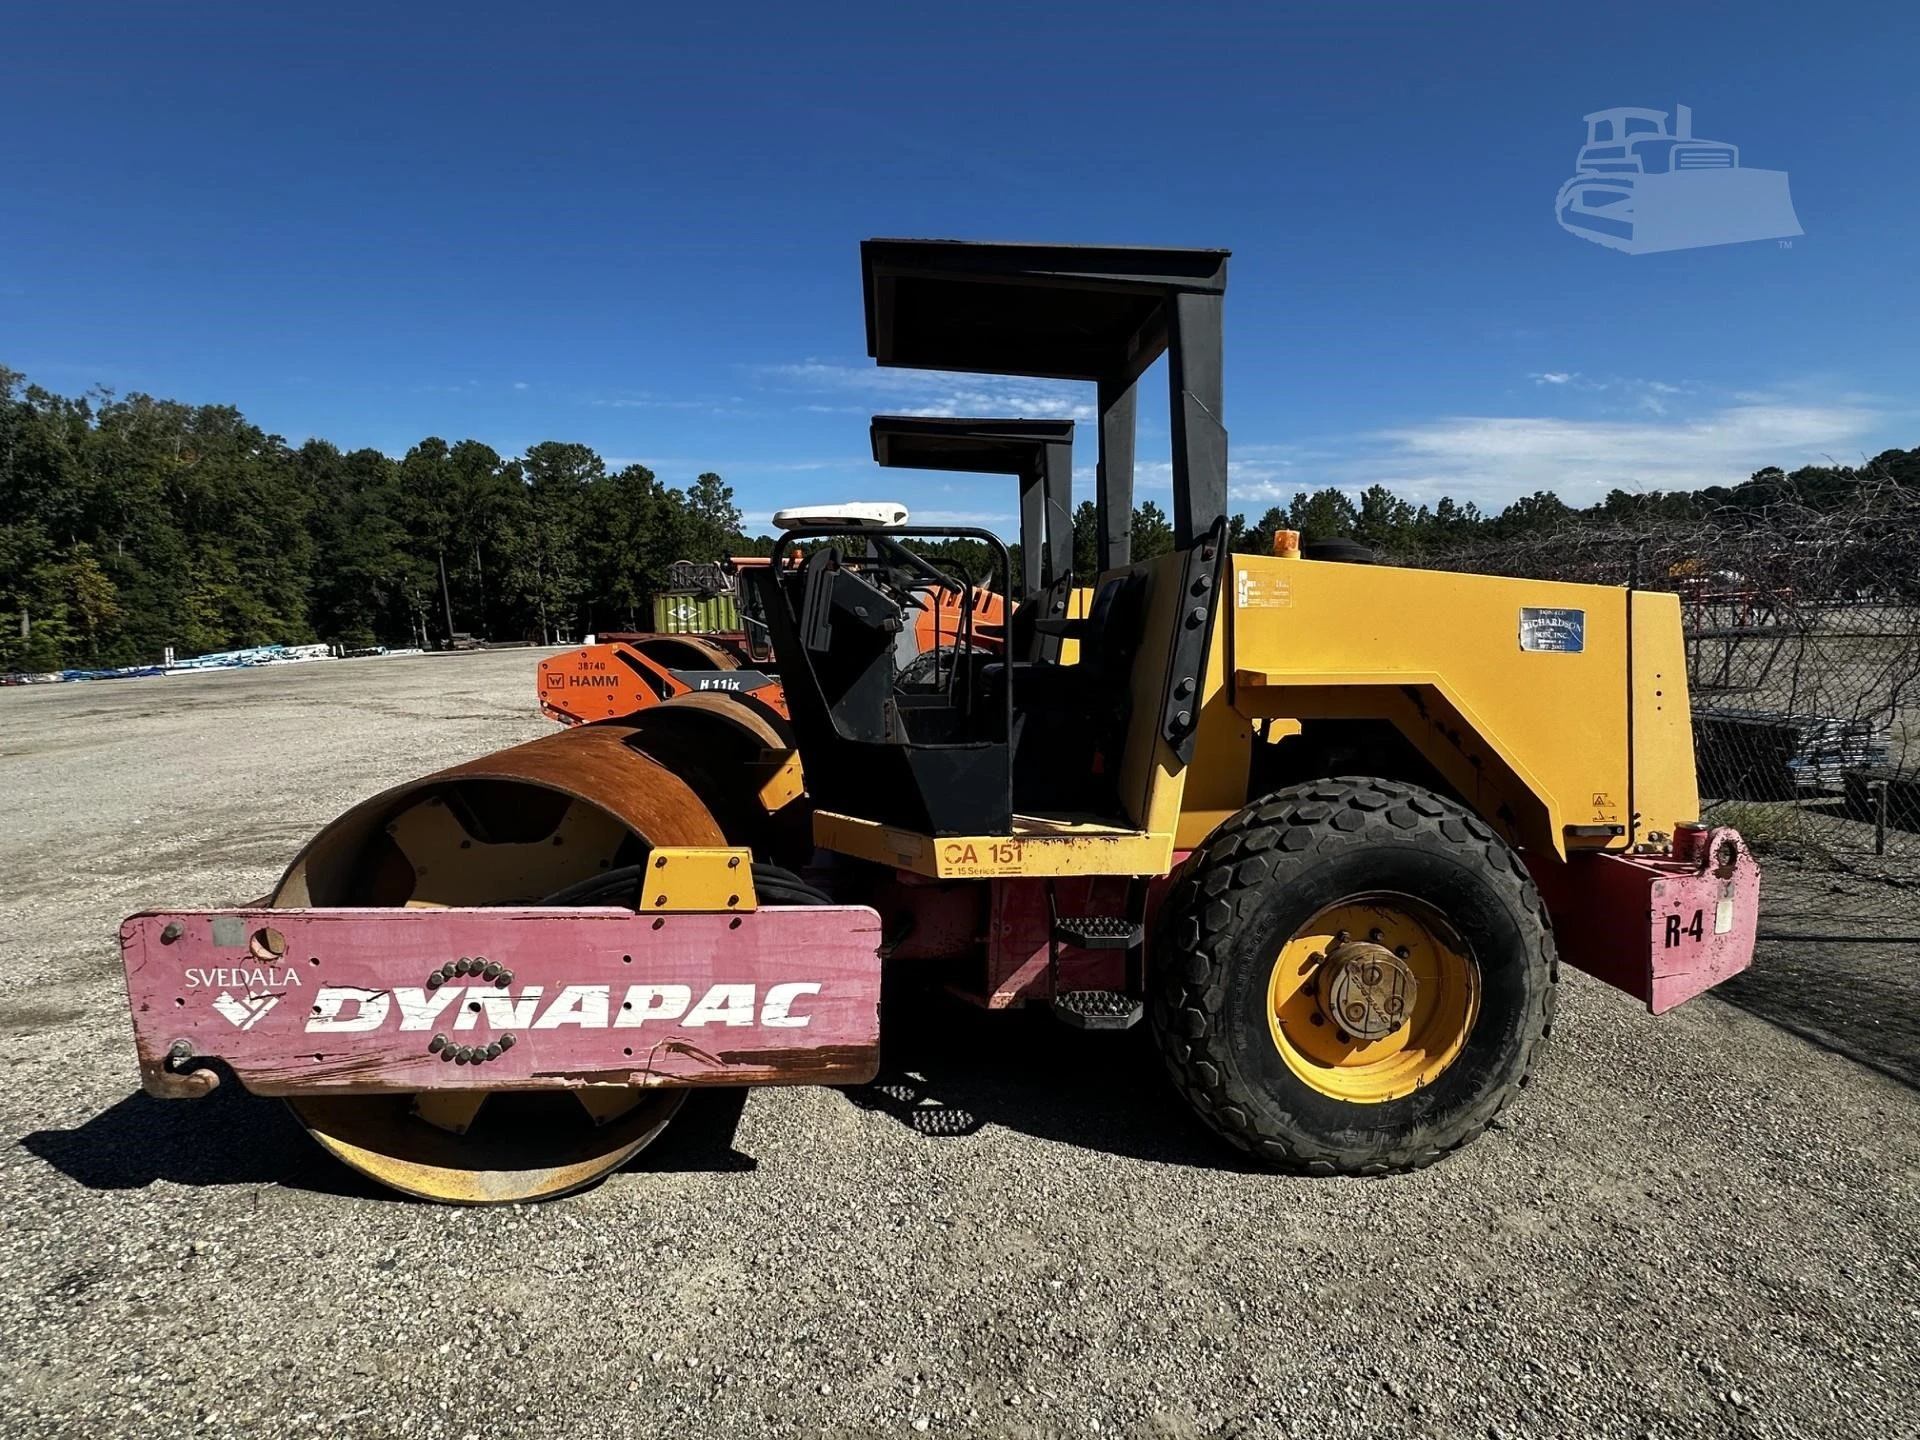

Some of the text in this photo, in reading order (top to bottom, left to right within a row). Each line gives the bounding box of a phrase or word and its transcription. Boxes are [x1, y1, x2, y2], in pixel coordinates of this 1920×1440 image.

[569, 675, 619, 687] HAMM
[699, 679, 710, 690] H
[944, 843, 1022, 864] CA 151
[967, 866, 996, 875] Series
[1664, 909, 1704, 949] R-4
[184, 967, 303, 988] SVEDALA
[304, 982, 822, 1034] DYNAPAC
